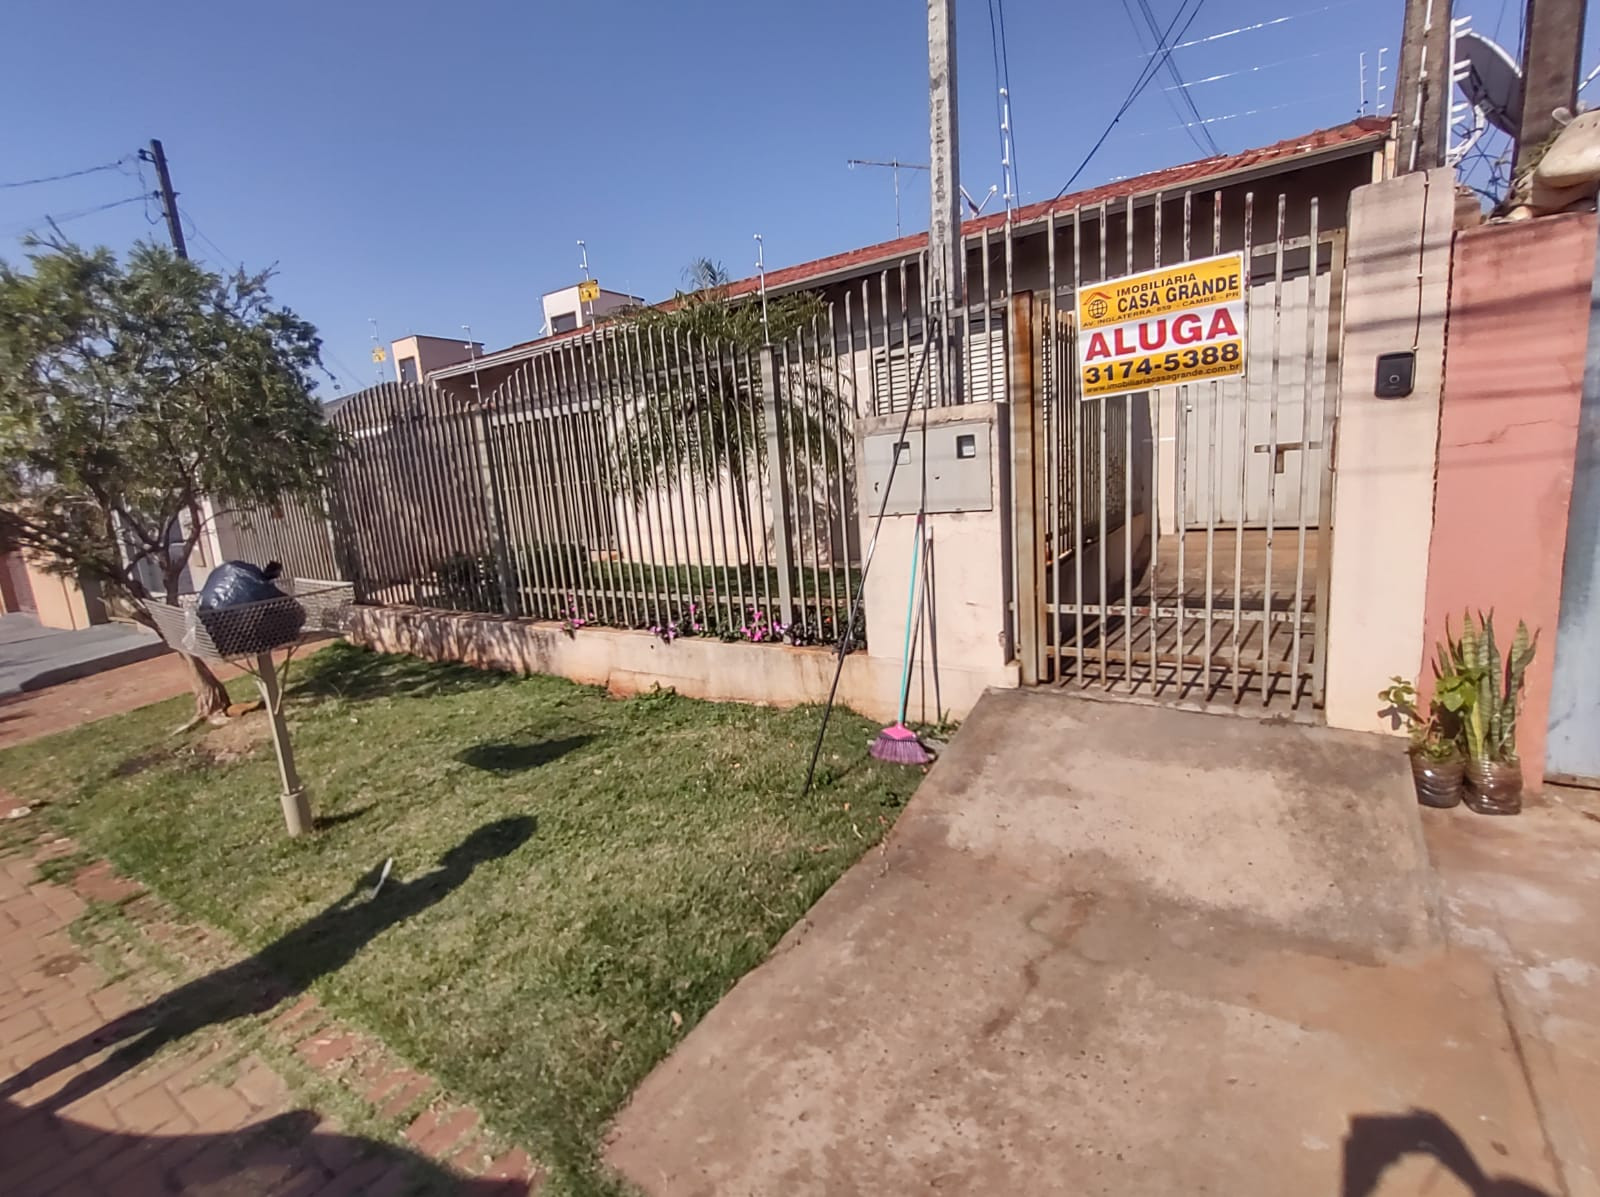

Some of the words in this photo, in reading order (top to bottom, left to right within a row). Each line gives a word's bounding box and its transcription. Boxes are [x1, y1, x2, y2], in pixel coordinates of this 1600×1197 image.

[1118, 291, 1160, 312] CASA
[1166, 274, 1238, 303] GRANDE
[1085, 307, 1238, 361] ALUGA
[1086, 343, 1239, 384] 3174-5388
[1086, 363, 1240, 393] www.imobiliariacasagrande.com.br
